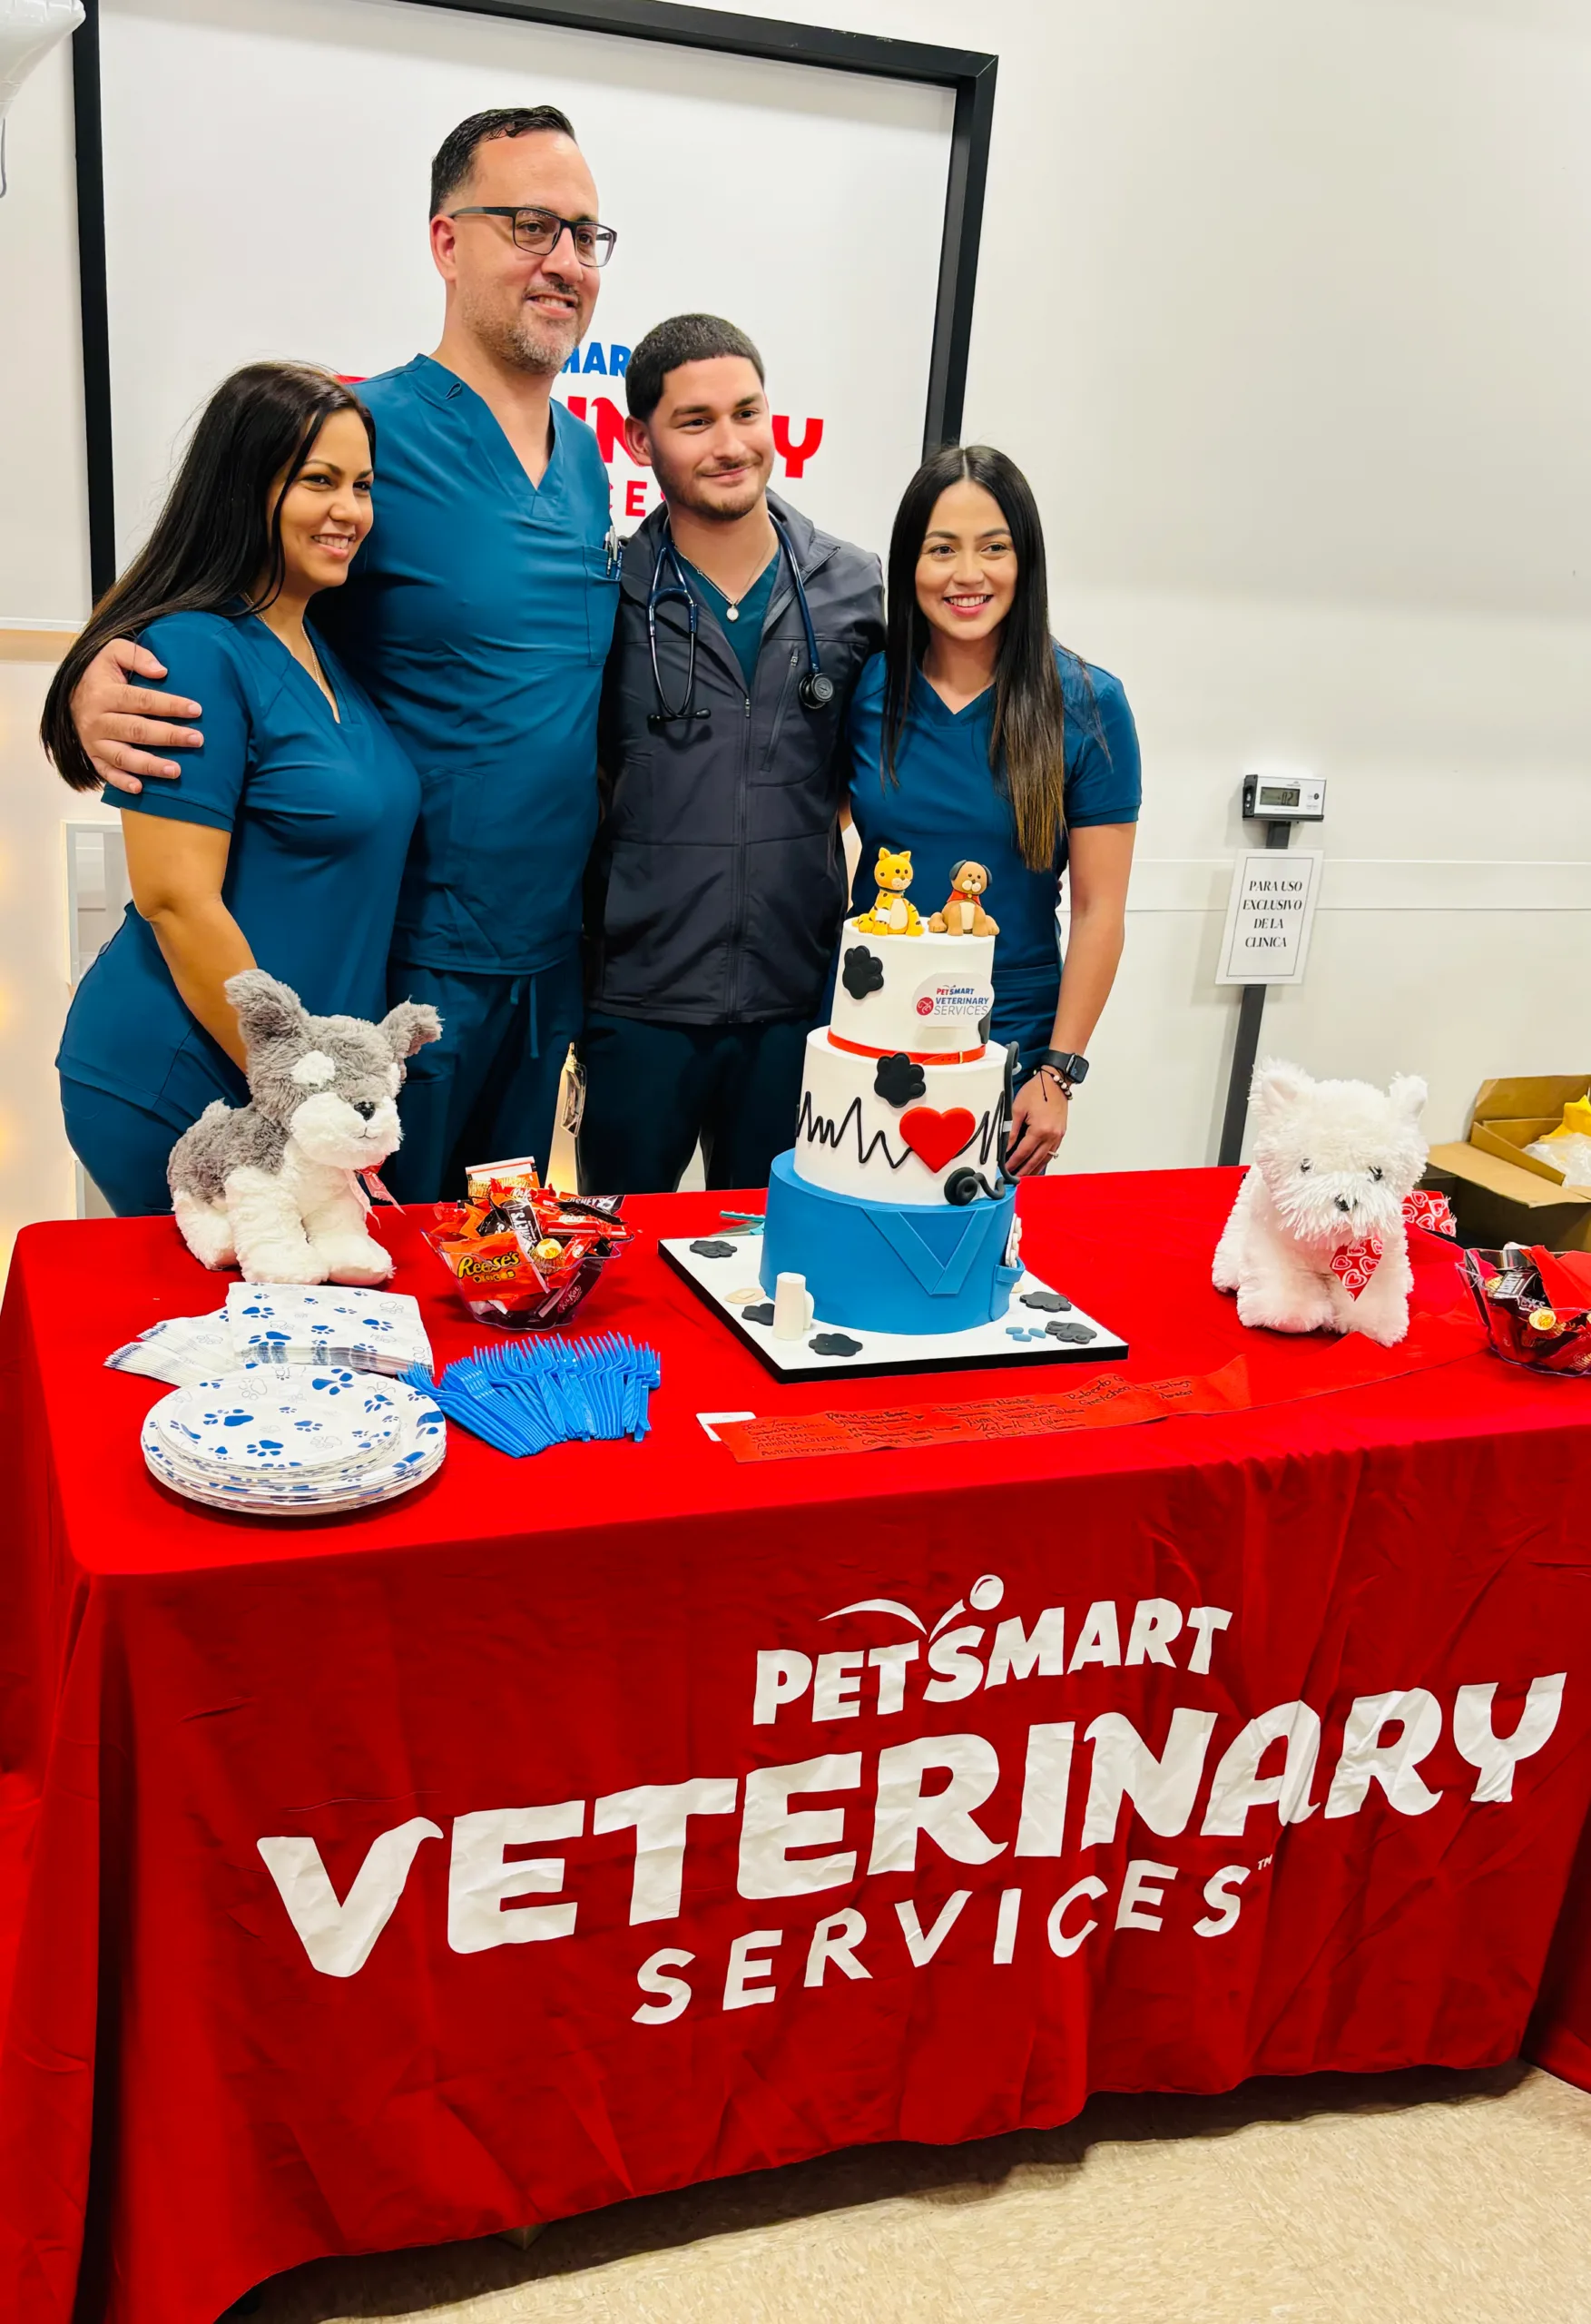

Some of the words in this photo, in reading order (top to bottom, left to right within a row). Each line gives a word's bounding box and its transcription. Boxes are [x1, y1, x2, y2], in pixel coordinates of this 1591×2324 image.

[1249, 881, 1278, 891] PARA
[1281, 881, 1302, 891] USO
[1242, 899, 1302, 911] EXCLUSIVO
[1253, 918, 1268, 929] DE
[1270, 918, 1283, 929] LA
[1245, 937, 1287, 948] CLINICA
[934, 1005, 988, 1015] SERVICES
[753, 1598, 1233, 1725] PETSMART
[257, 1673, 1567, 1977] VETERINARY
[632, 1866, 1251, 2024] SERVICES
